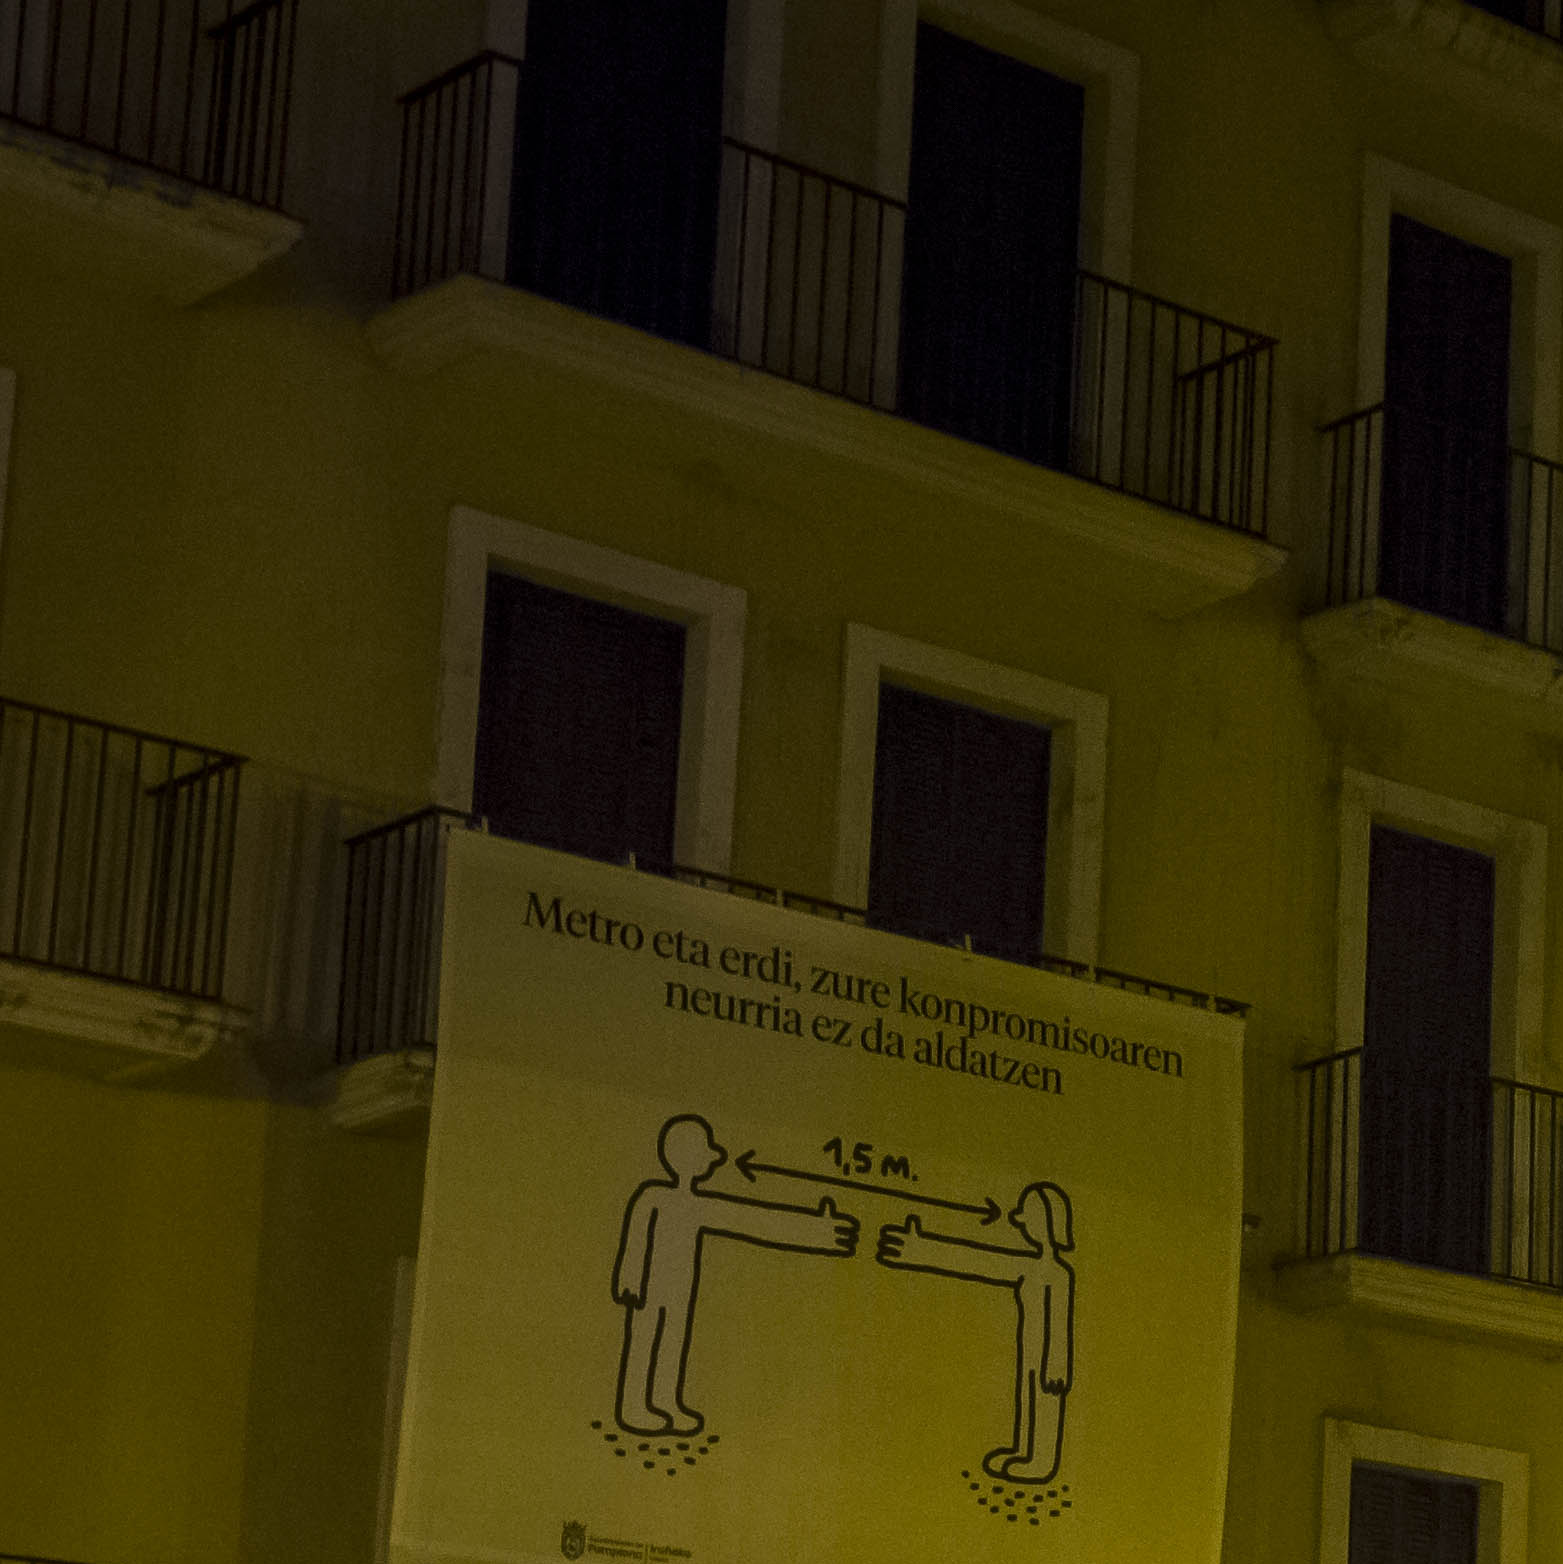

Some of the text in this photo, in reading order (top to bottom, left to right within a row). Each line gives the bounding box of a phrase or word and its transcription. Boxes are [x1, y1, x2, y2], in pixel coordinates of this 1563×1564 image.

[523, 892, 1183, 1077] Metro eta erdi, zure konpromisoaren
[664, 980, 1064, 1095] neurria ez da aldatzen
[823, 1137, 873, 1176] 1,5
